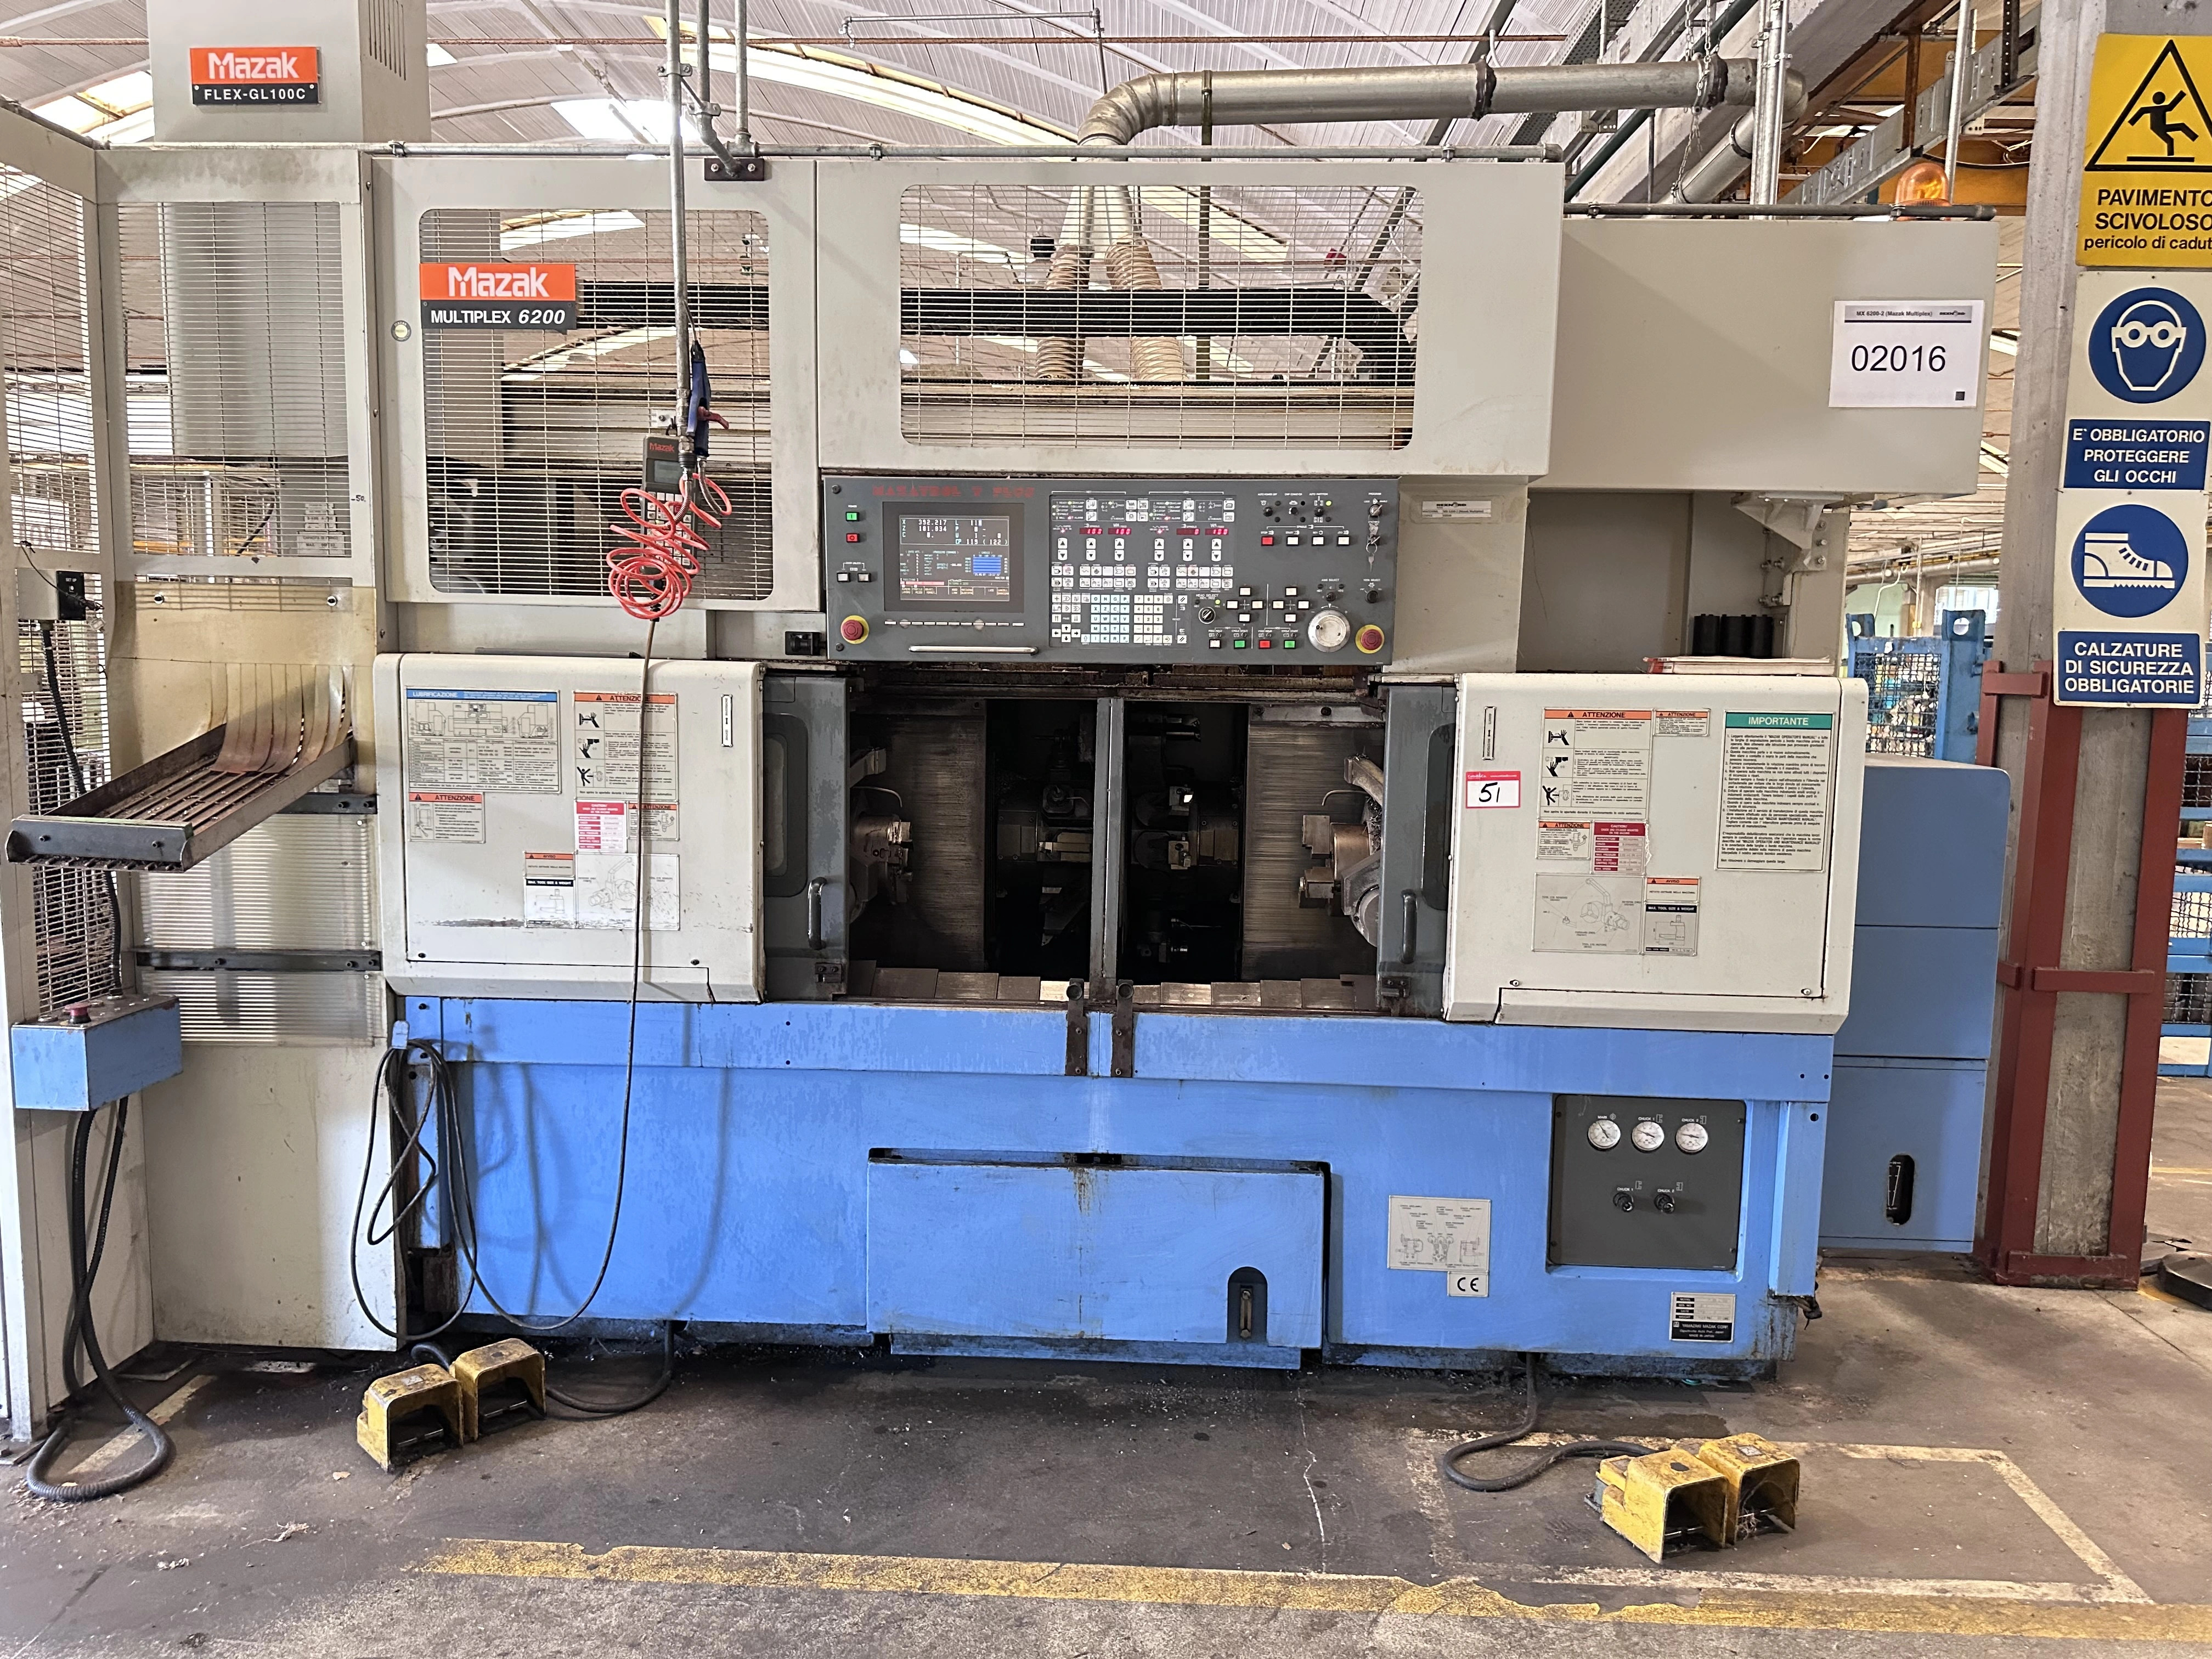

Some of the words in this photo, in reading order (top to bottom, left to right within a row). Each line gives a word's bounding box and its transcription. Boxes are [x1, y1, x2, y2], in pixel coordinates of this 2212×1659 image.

[208, 52, 299, 79] Mazak
[205, 89, 306, 99] FLEX-GL100C
[2097, 189, 2212, 207] PAVIMENTO
[2095, 213, 2212, 230] SCIVOLOSO
[2084, 236, 2147, 250] pericolo
[2152, 236, 2165, 249] di
[2170, 236, 2212, 250] cadut
[448, 267, 550, 297] Mazak
[431, 311, 511, 324] MULTIPLEX
[518, 309, 565, 324] 6200
[1851, 345, 1946, 372] 02016
[2090, 429, 2205, 443] OBBLIGATORIO
[650, 442, 675, 452] Mazak
[2084, 450, 2190, 463] PROTEGGERE
[2094, 470, 2118, 482] GLI
[2125, 470, 2176, 483] OCCHI
[2075, 642, 2182, 658] CALZATURE
[2066, 661, 2082, 674] DI
[2090, 661, 2194, 675] SICUREZZA
[2064, 677, 2194, 694] OBBLIGATORIE
[1748, 716, 1809, 725] IMPORTANTE
[1479, 782, 1500, 803] 51
[1457, 1277, 1479, 1292] CE
